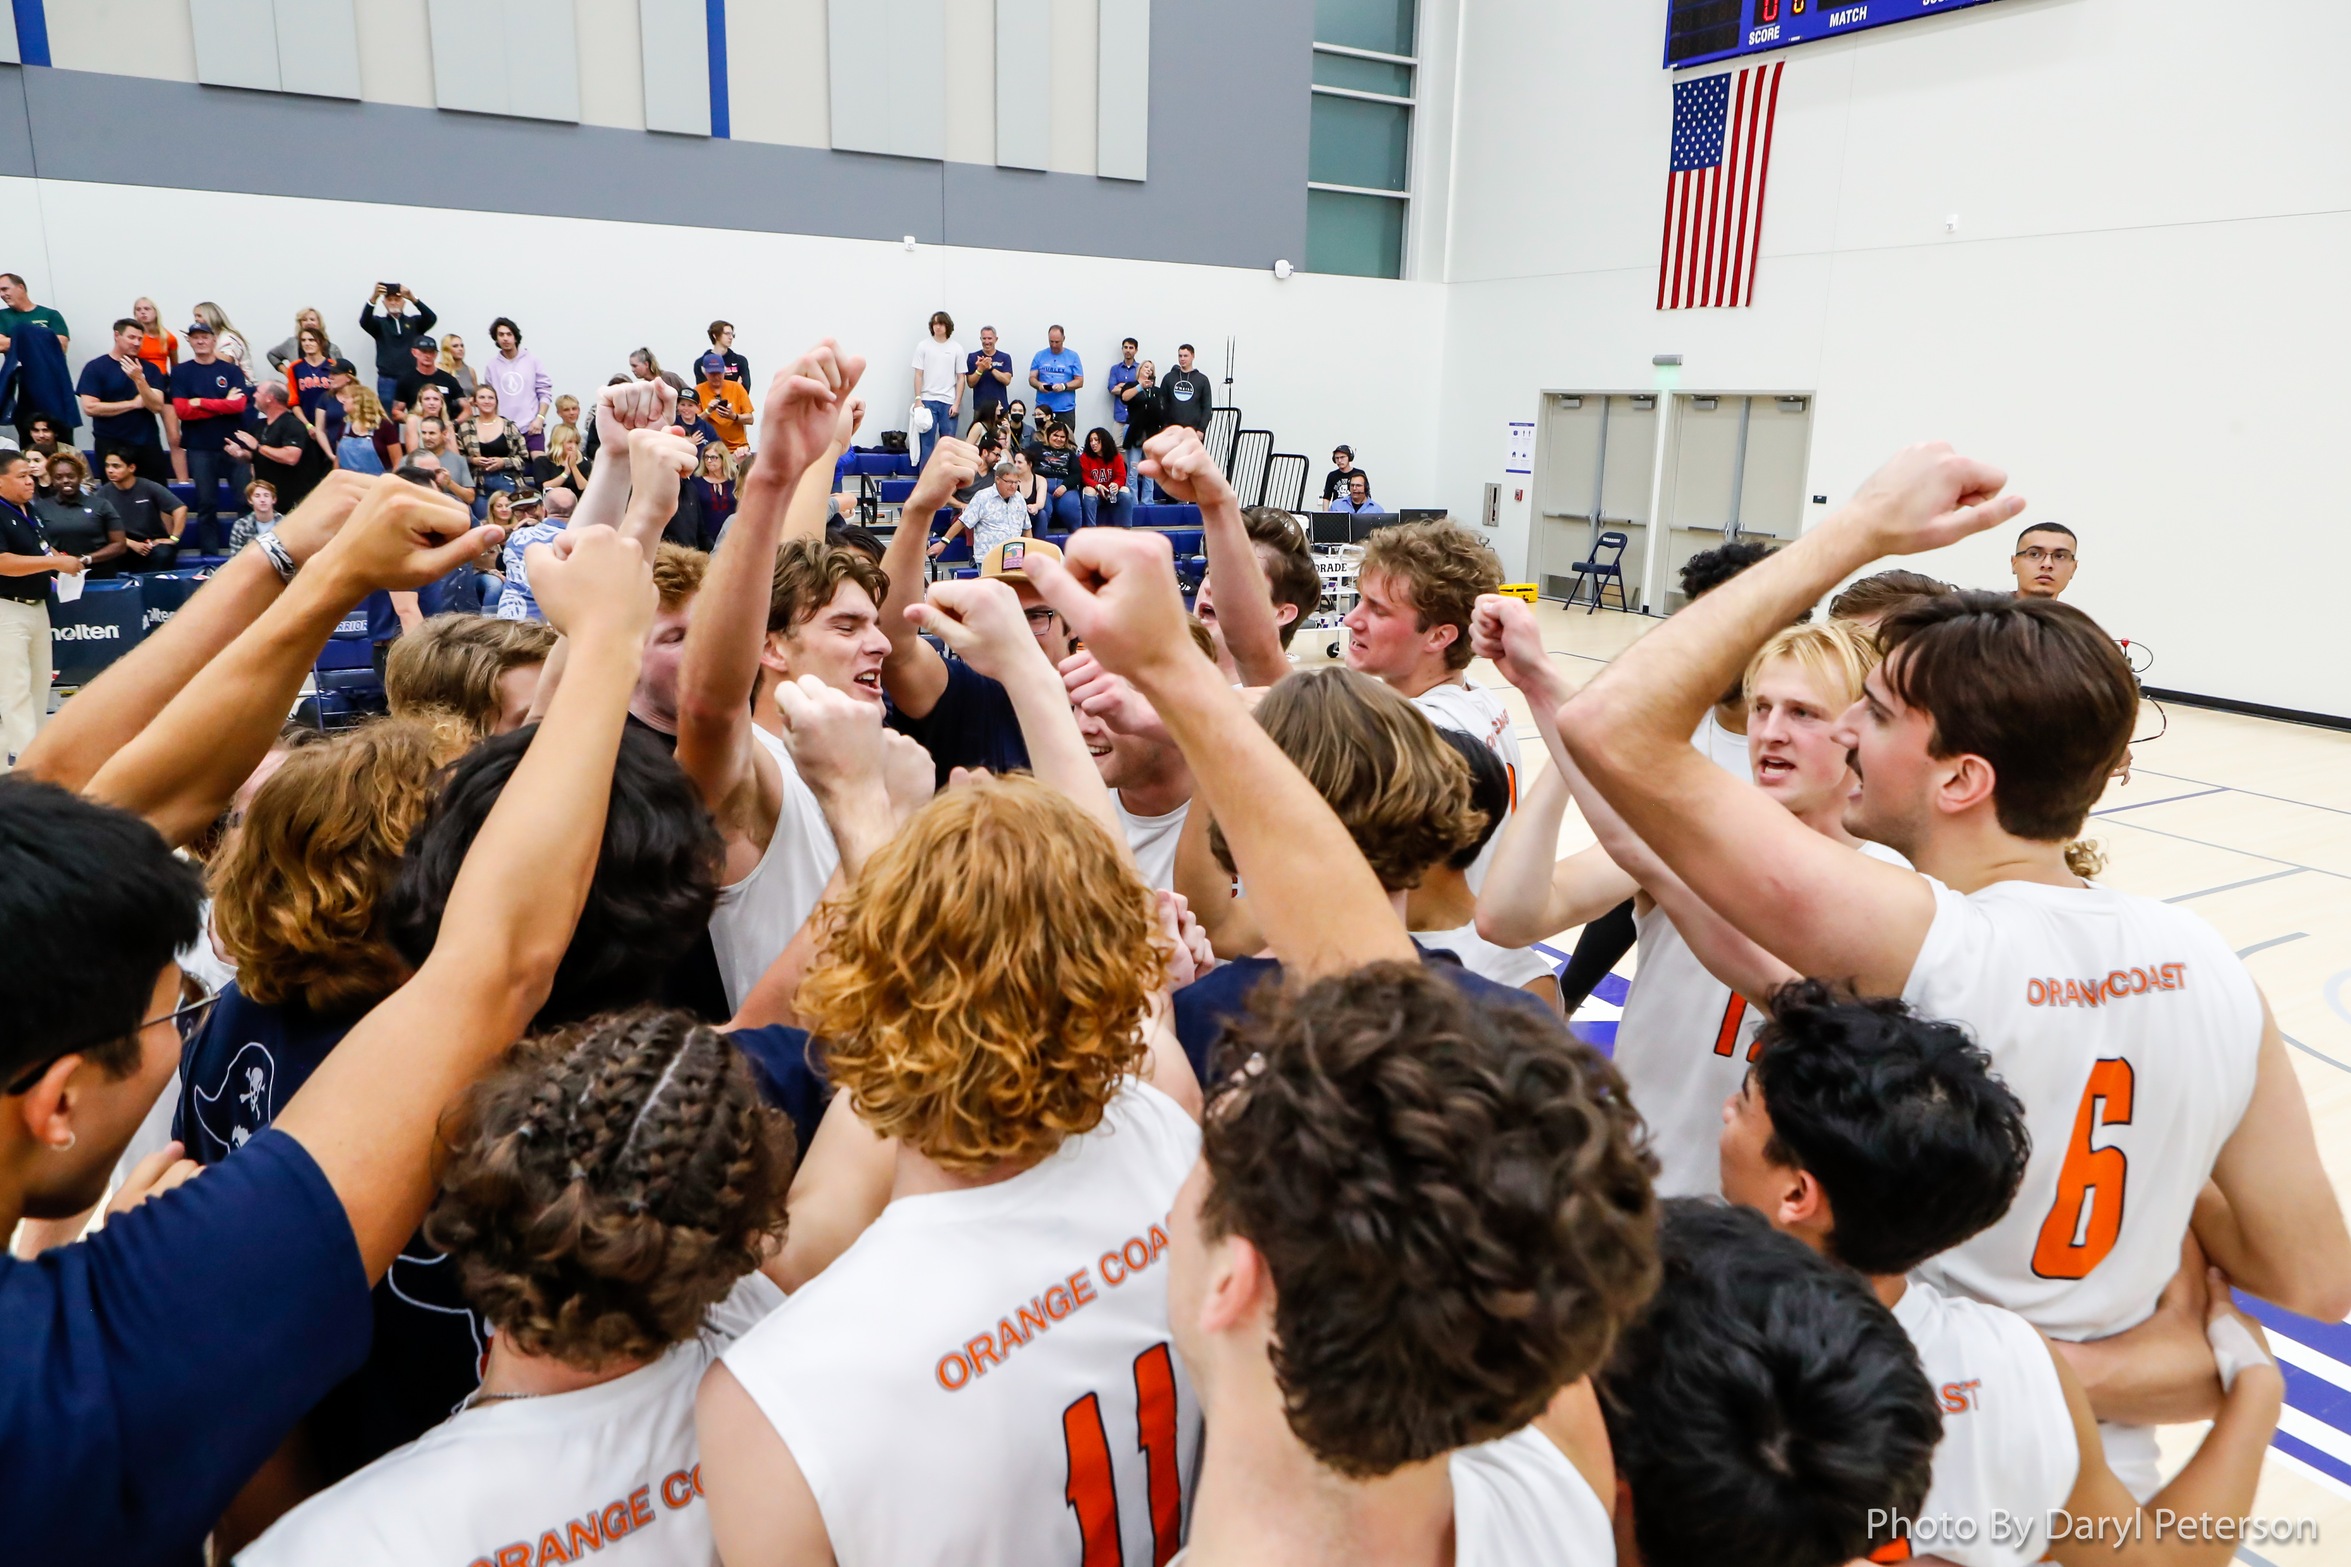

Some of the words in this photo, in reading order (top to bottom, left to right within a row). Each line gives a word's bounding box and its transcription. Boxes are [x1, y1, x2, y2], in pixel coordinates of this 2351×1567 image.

[1829, 6, 1868, 28] MATCH
[1748, 25, 1780, 46] SCORE
[298, 376, 331, 391] COAS
[2027, 977, 2107, 1008] ORAN
[2107, 962, 2187, 998] COAST
[2031, 1056, 2135, 1280] 6
[936, 1268, 1098, 1391] ORANGE
[1098, 1222, 1170, 1286] COA
